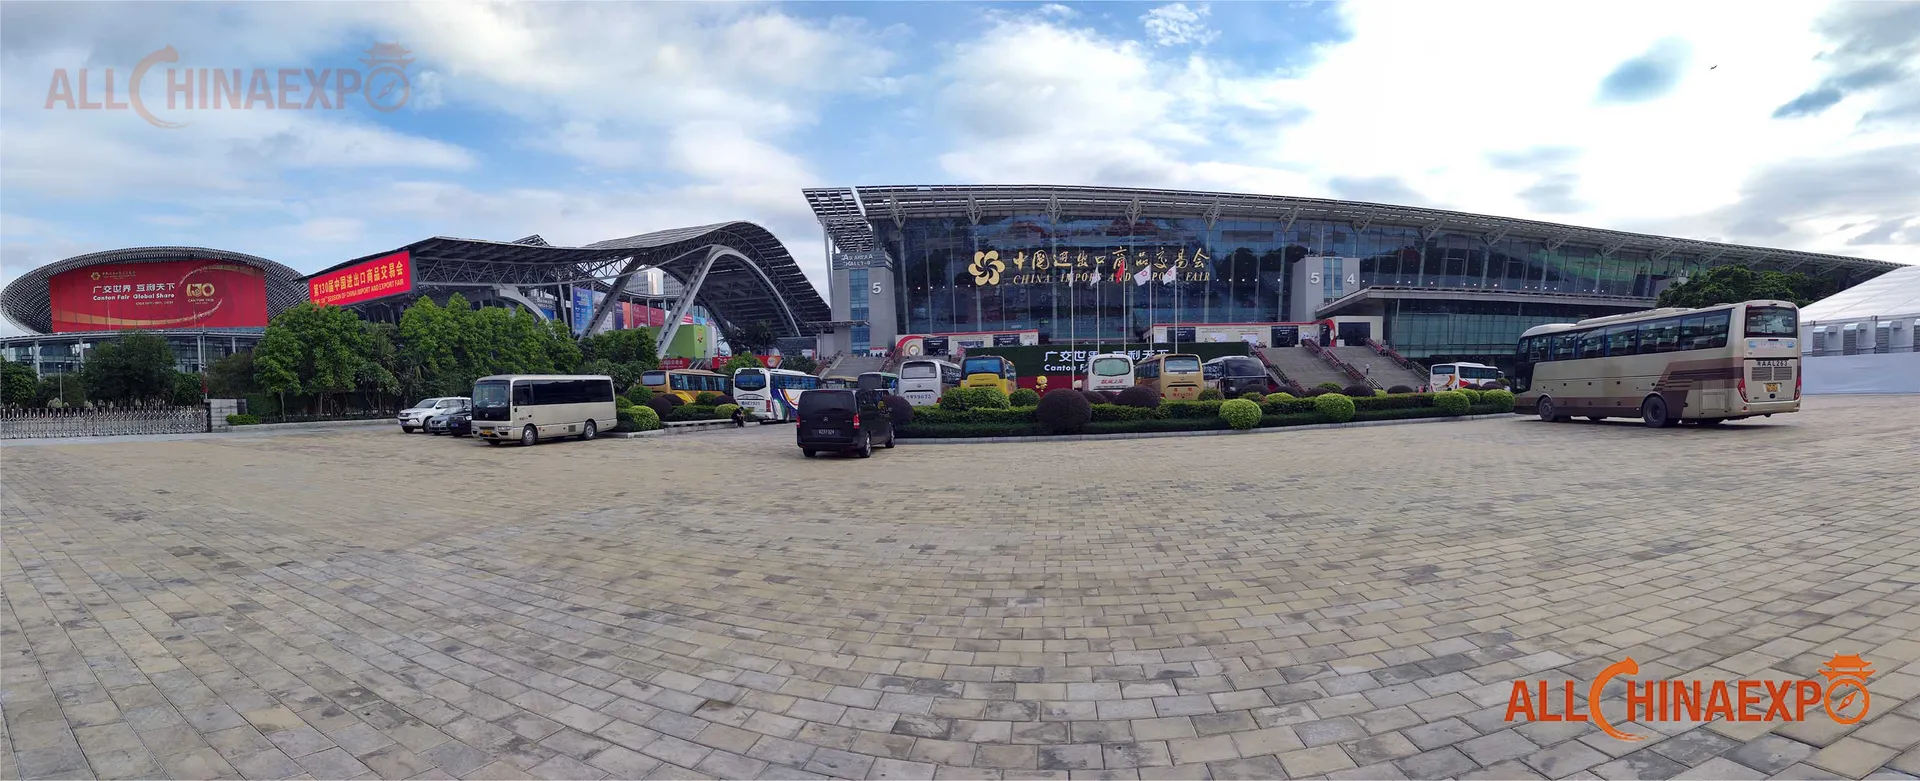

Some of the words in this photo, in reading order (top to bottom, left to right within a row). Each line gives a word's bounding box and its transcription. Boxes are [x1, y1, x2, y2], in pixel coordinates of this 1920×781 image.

[313, 260, 404, 297] 第130届中国进出口商品交易会
[1013, 274, 1050, 284] CHINA
[1060, 272, 1102, 283] IMPO
[1107, 272, 1131, 282] AD
[1185, 271, 1210, 281] FAIR
[1310, 272, 1320, 284] 5
[1346, 272, 1356, 284] 4
[92, 284, 132, 294] 广交世界
[136, 282, 175, 292] 互利天下
[872, 282, 882, 294] 5
